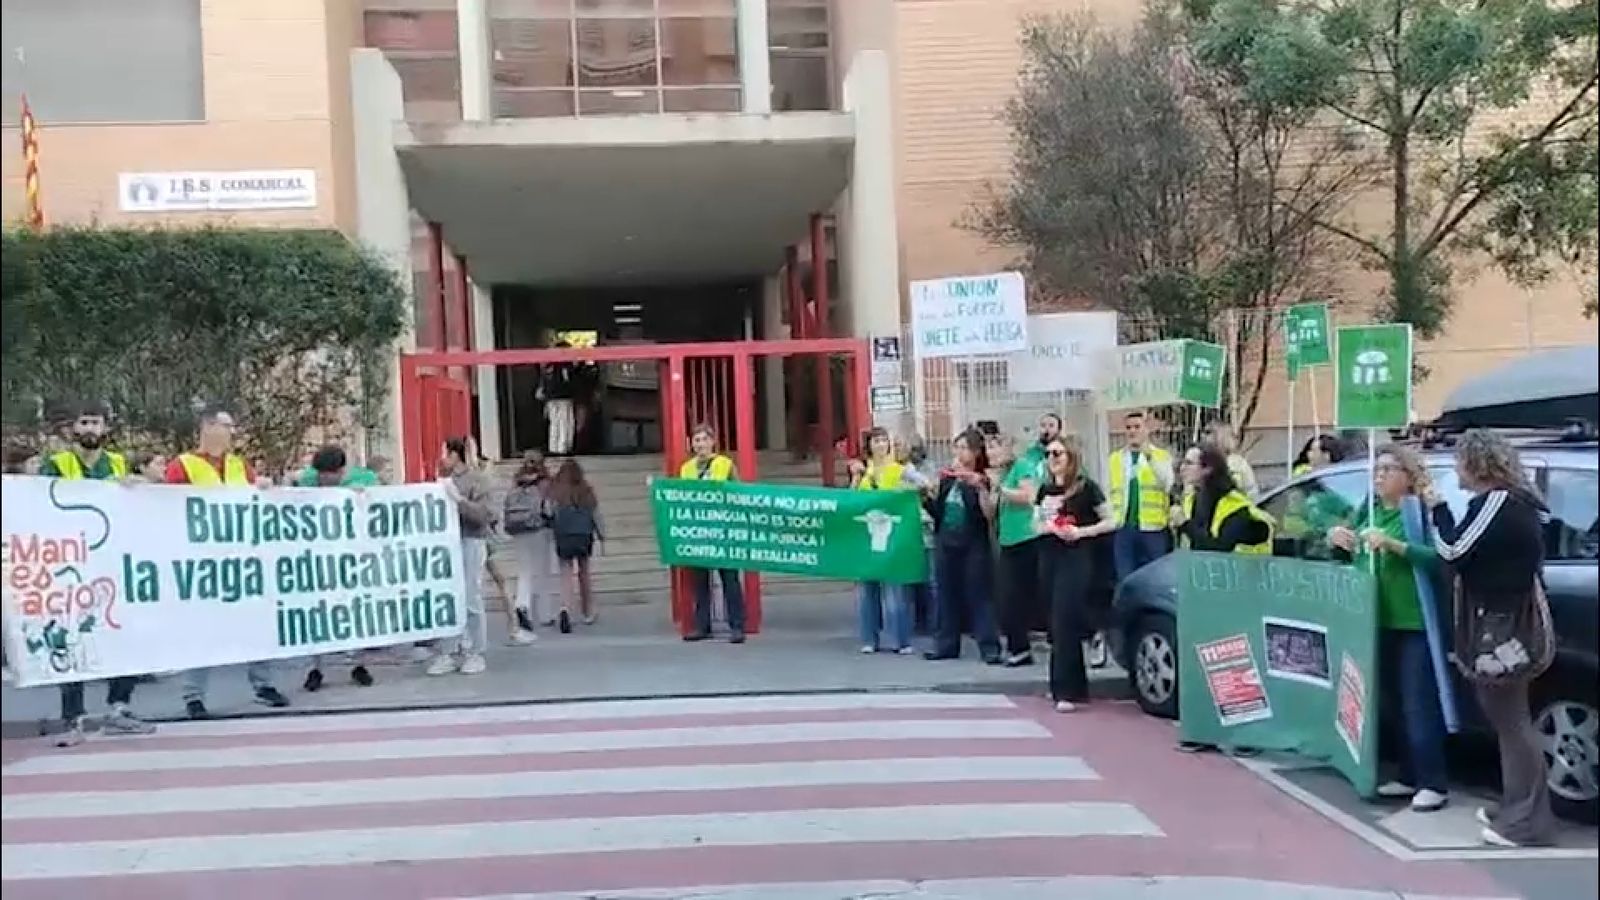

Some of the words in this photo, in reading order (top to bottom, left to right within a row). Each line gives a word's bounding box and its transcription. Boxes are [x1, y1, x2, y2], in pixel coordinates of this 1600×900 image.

[221, 178, 306, 191] COMARCAL
[774, 496, 795, 510] NO
[186, 494, 356, 546] Burjassot
[367, 493, 447, 538] amb
[677, 508, 692, 520] LA
[695, 509, 747, 523] LLENGUA
[751, 514, 769, 525] NO
[772, 514, 784, 526] ES
[670, 526, 724, 540] DOCENTS
[728, 528, 748, 541] PER
[752, 531, 767, 542] LA
[676, 545, 726, 558] CONTRA
[729, 547, 747, 560] LES
[751, 549, 818, 565] RETALLADES
[122, 553, 160, 602] la
[172, 555, 264, 602] vaga
[276, 542, 451, 595] educativa
[277, 589, 456, 647] indefinida
